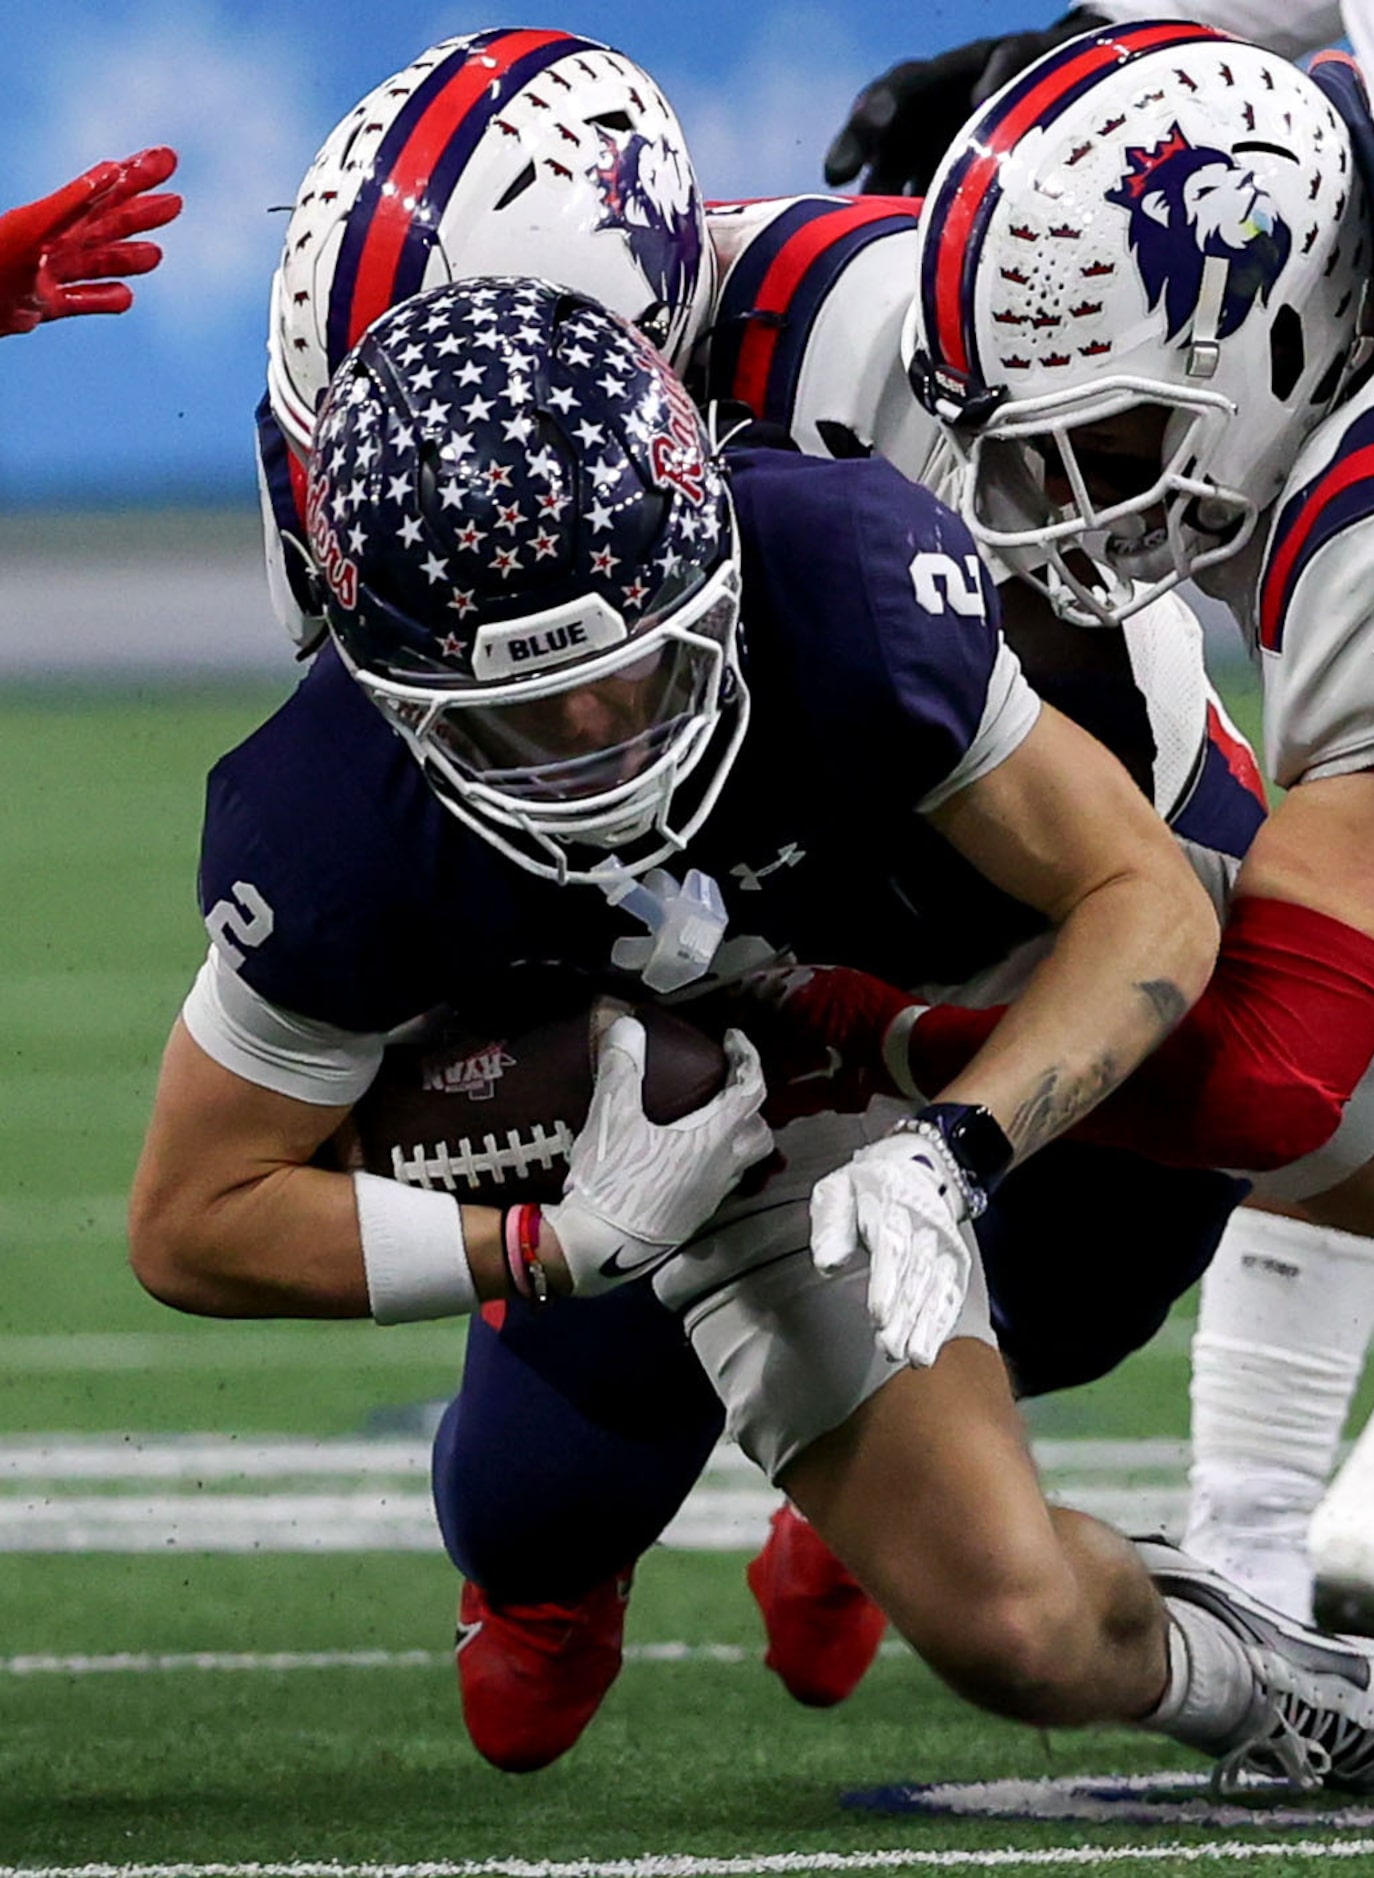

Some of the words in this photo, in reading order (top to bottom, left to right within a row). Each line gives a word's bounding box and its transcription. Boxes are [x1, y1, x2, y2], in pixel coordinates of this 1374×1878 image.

[909, 552, 986, 617] 2
[508, 621, 588, 661] BLUE
[205, 881, 274, 970] 2
